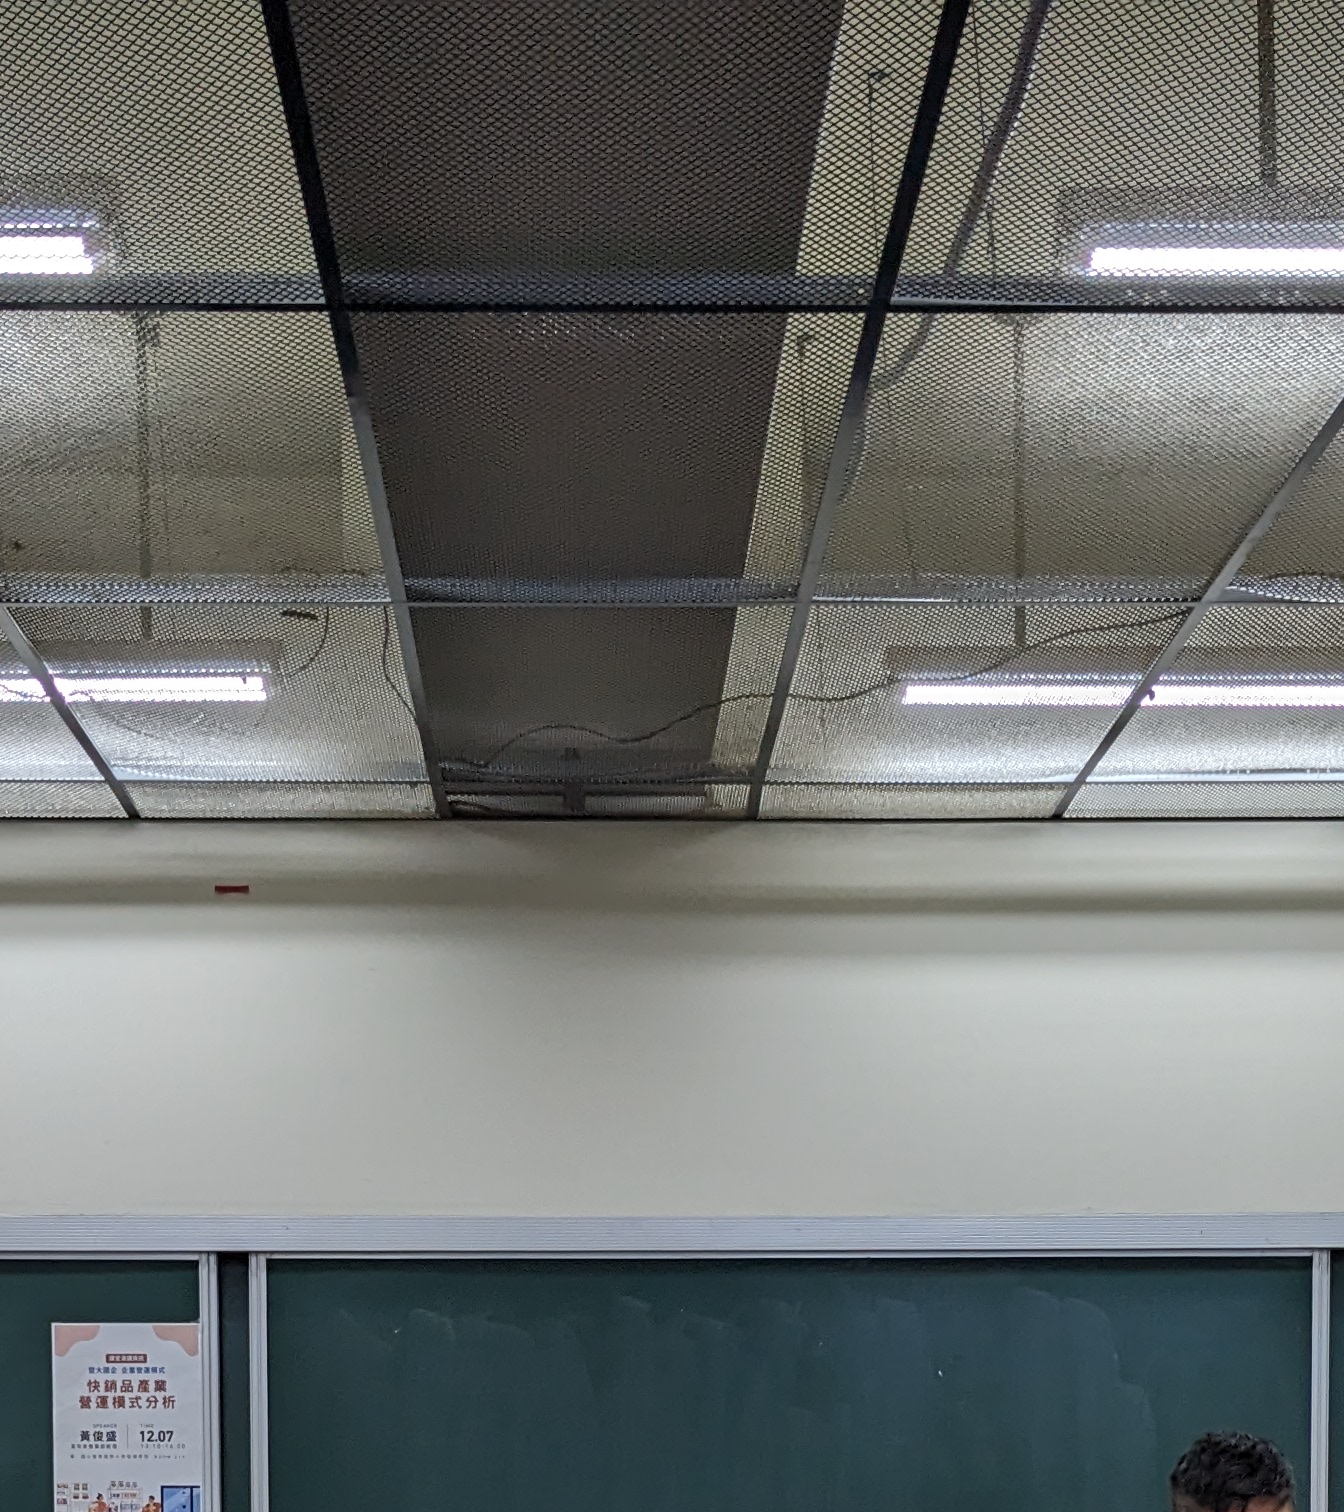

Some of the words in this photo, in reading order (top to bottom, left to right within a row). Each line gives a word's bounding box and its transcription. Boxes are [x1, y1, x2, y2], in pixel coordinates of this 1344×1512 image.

[86, 1379, 167, 1393] 快銷品產業
[79, 1395, 176, 1410] 營運模式分析
[139, 1430, 174, 1443] 12.07
